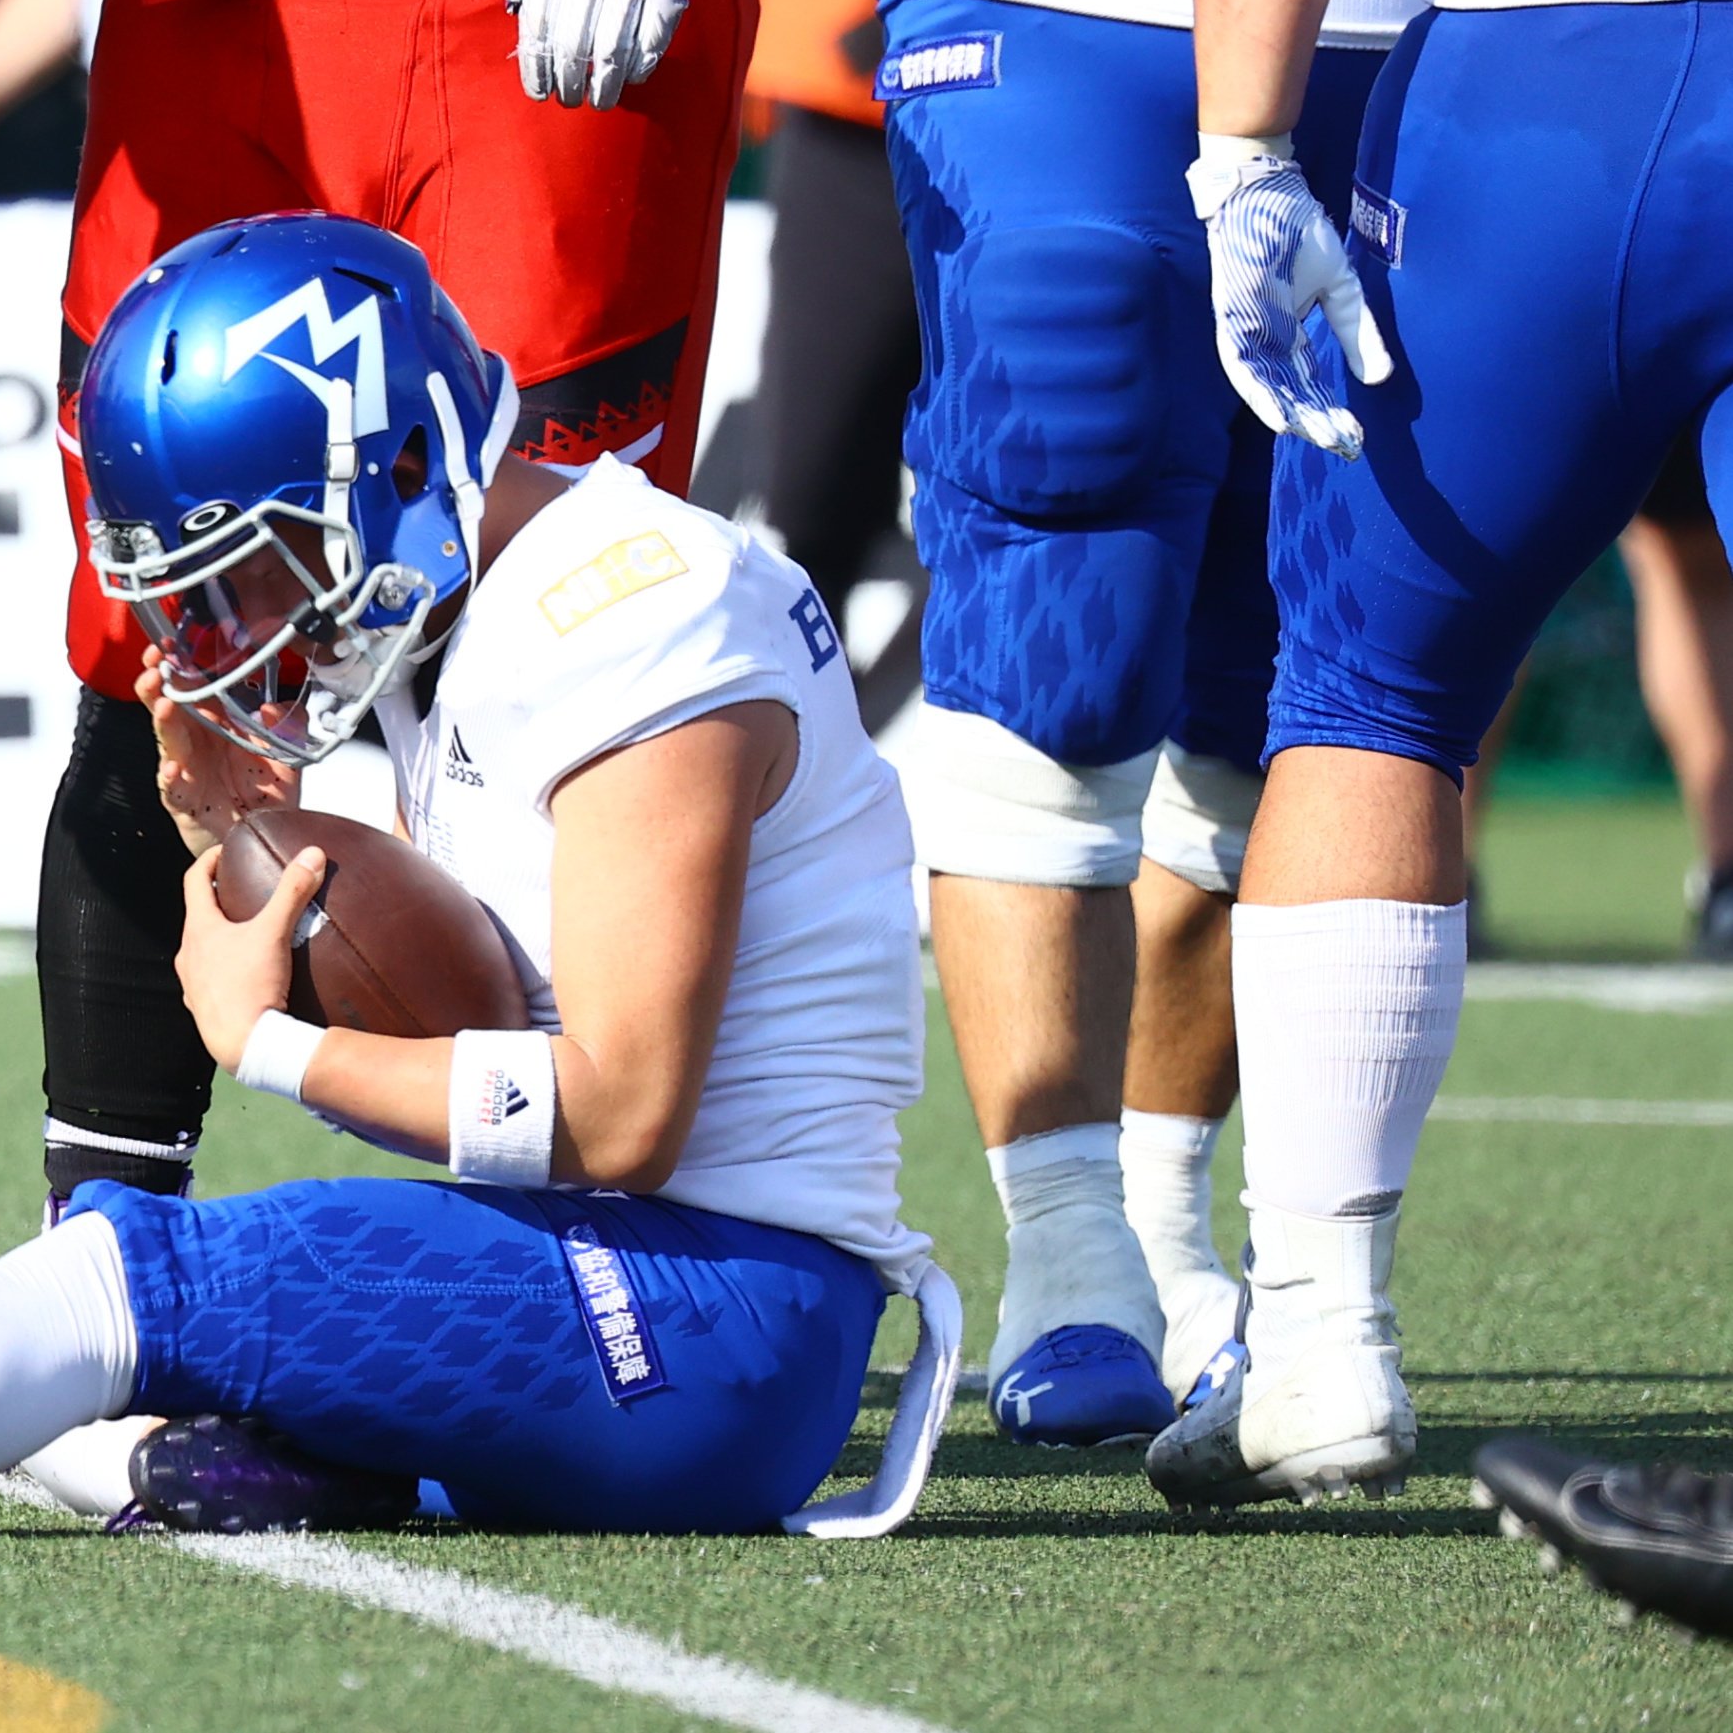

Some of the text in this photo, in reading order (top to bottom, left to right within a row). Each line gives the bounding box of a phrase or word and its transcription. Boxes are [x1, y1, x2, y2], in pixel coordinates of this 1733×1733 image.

[491, 1069, 506, 1126] adidas
[572, 1247, 652, 1386] 協和警備保障
